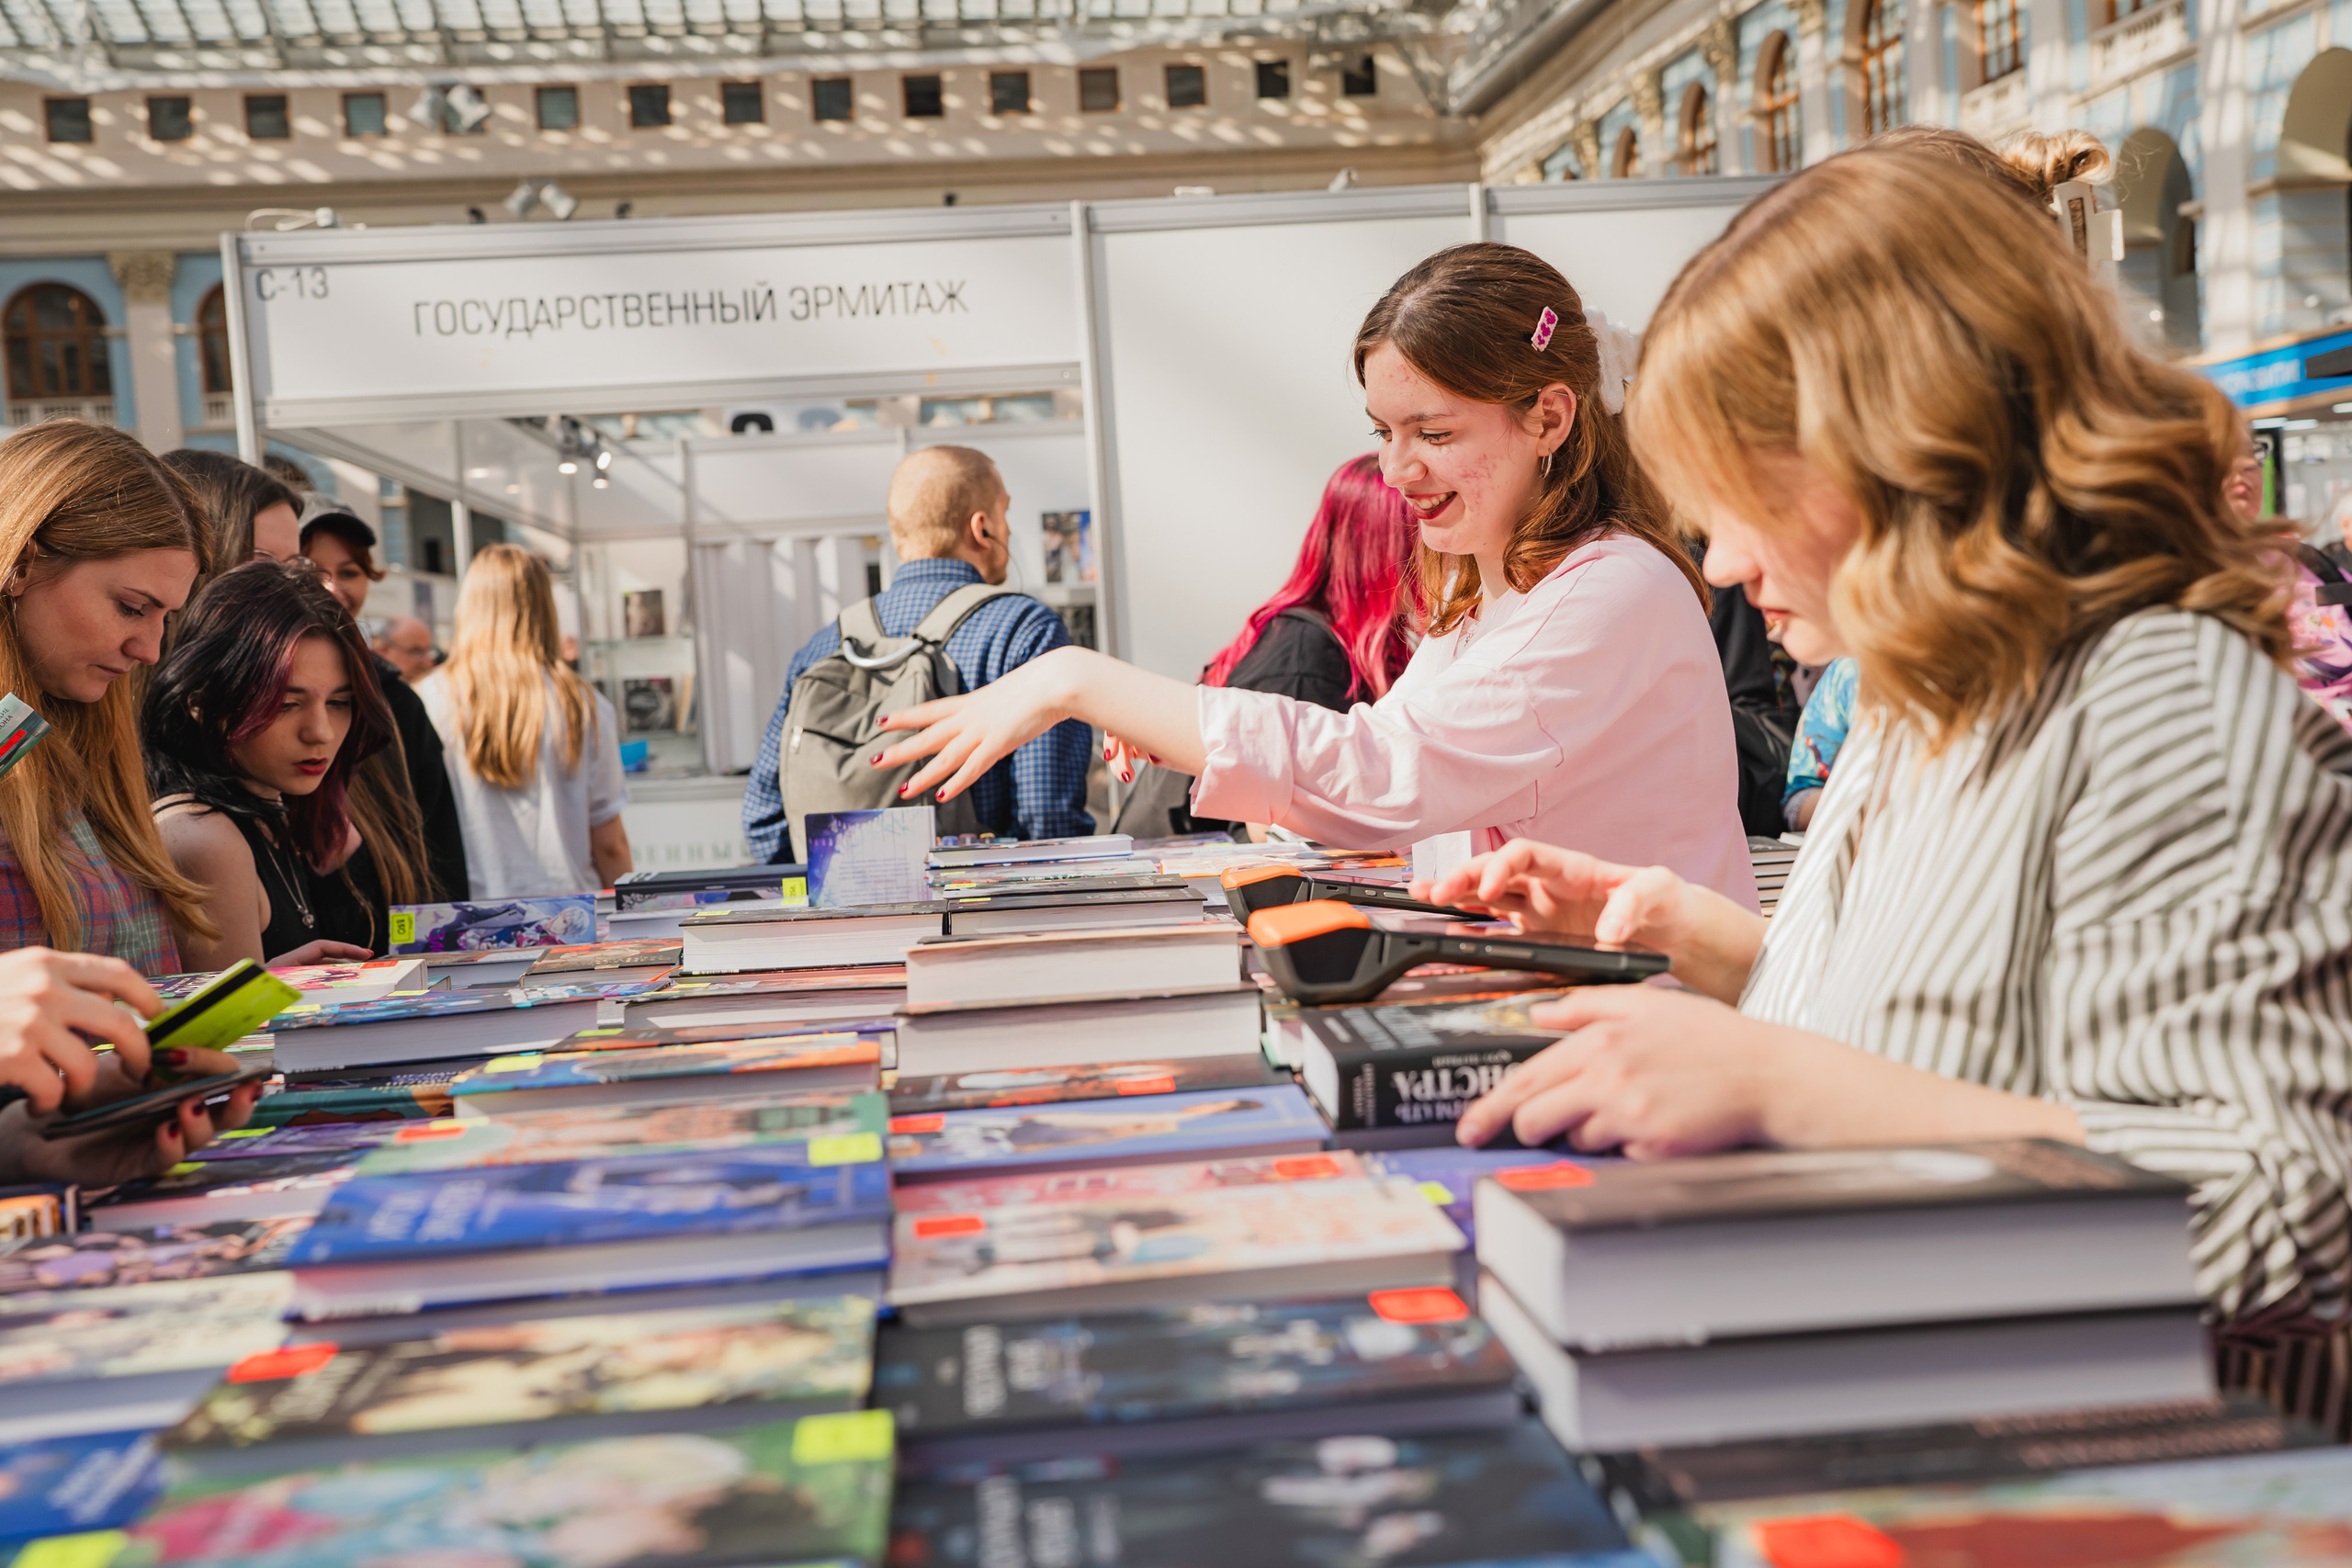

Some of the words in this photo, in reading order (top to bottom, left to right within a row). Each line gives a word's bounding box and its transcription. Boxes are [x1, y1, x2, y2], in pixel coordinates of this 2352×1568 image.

[255, 265, 329, 302] С-13
[413, 279, 777, 341] ГОСУДАРСТВЕННЫЙ
[789, 279, 969, 322] ЭРМИТАЖ
